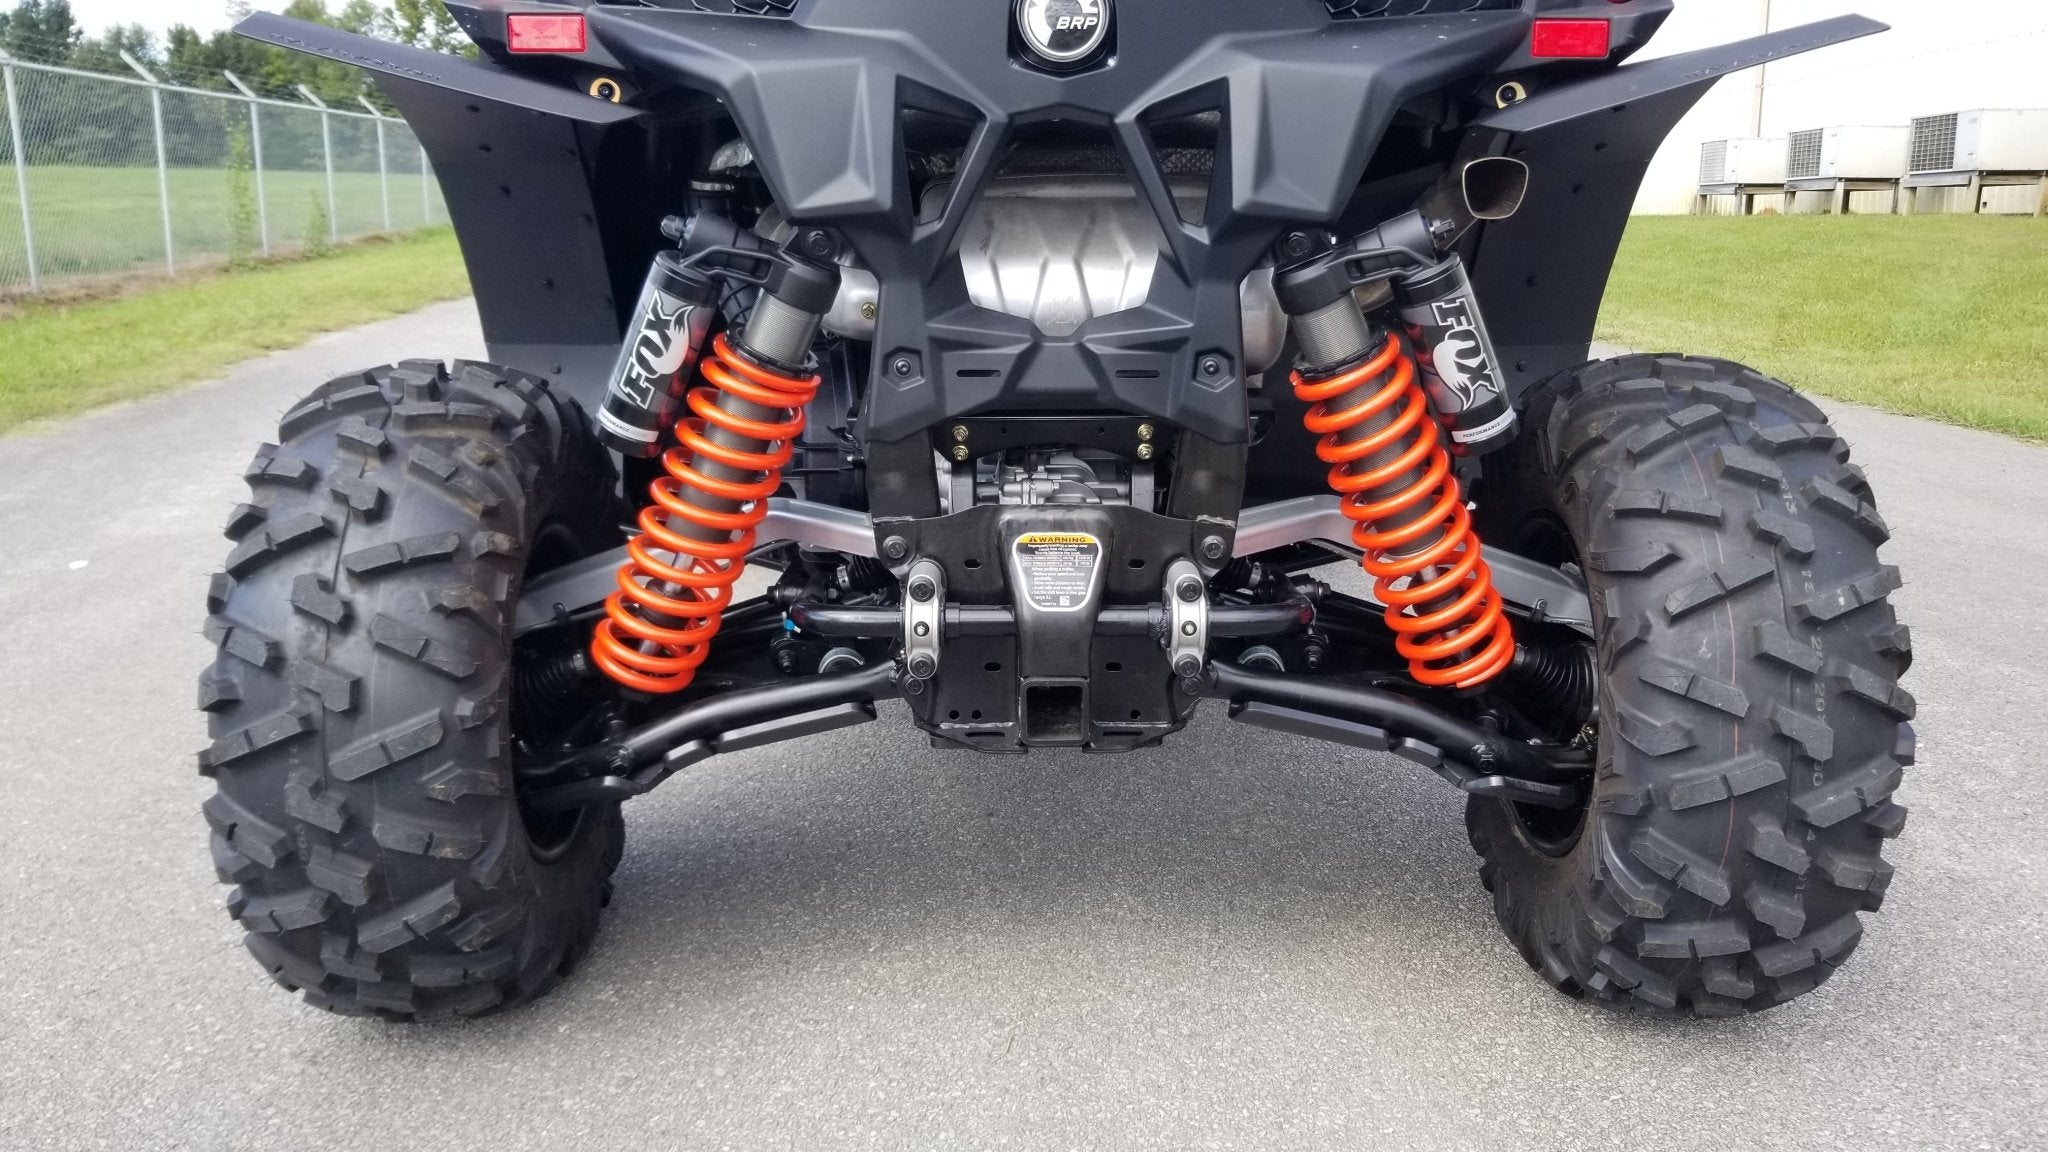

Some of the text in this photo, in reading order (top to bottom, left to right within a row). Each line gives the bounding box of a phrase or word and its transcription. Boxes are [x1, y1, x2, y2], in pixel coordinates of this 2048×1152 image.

[1056, 16, 1097, 30] BRP
[619, 288, 693, 410] FOX
[1431, 298, 1500, 404] FOX
[1462, 421, 1501, 439] PERFORMANCE
